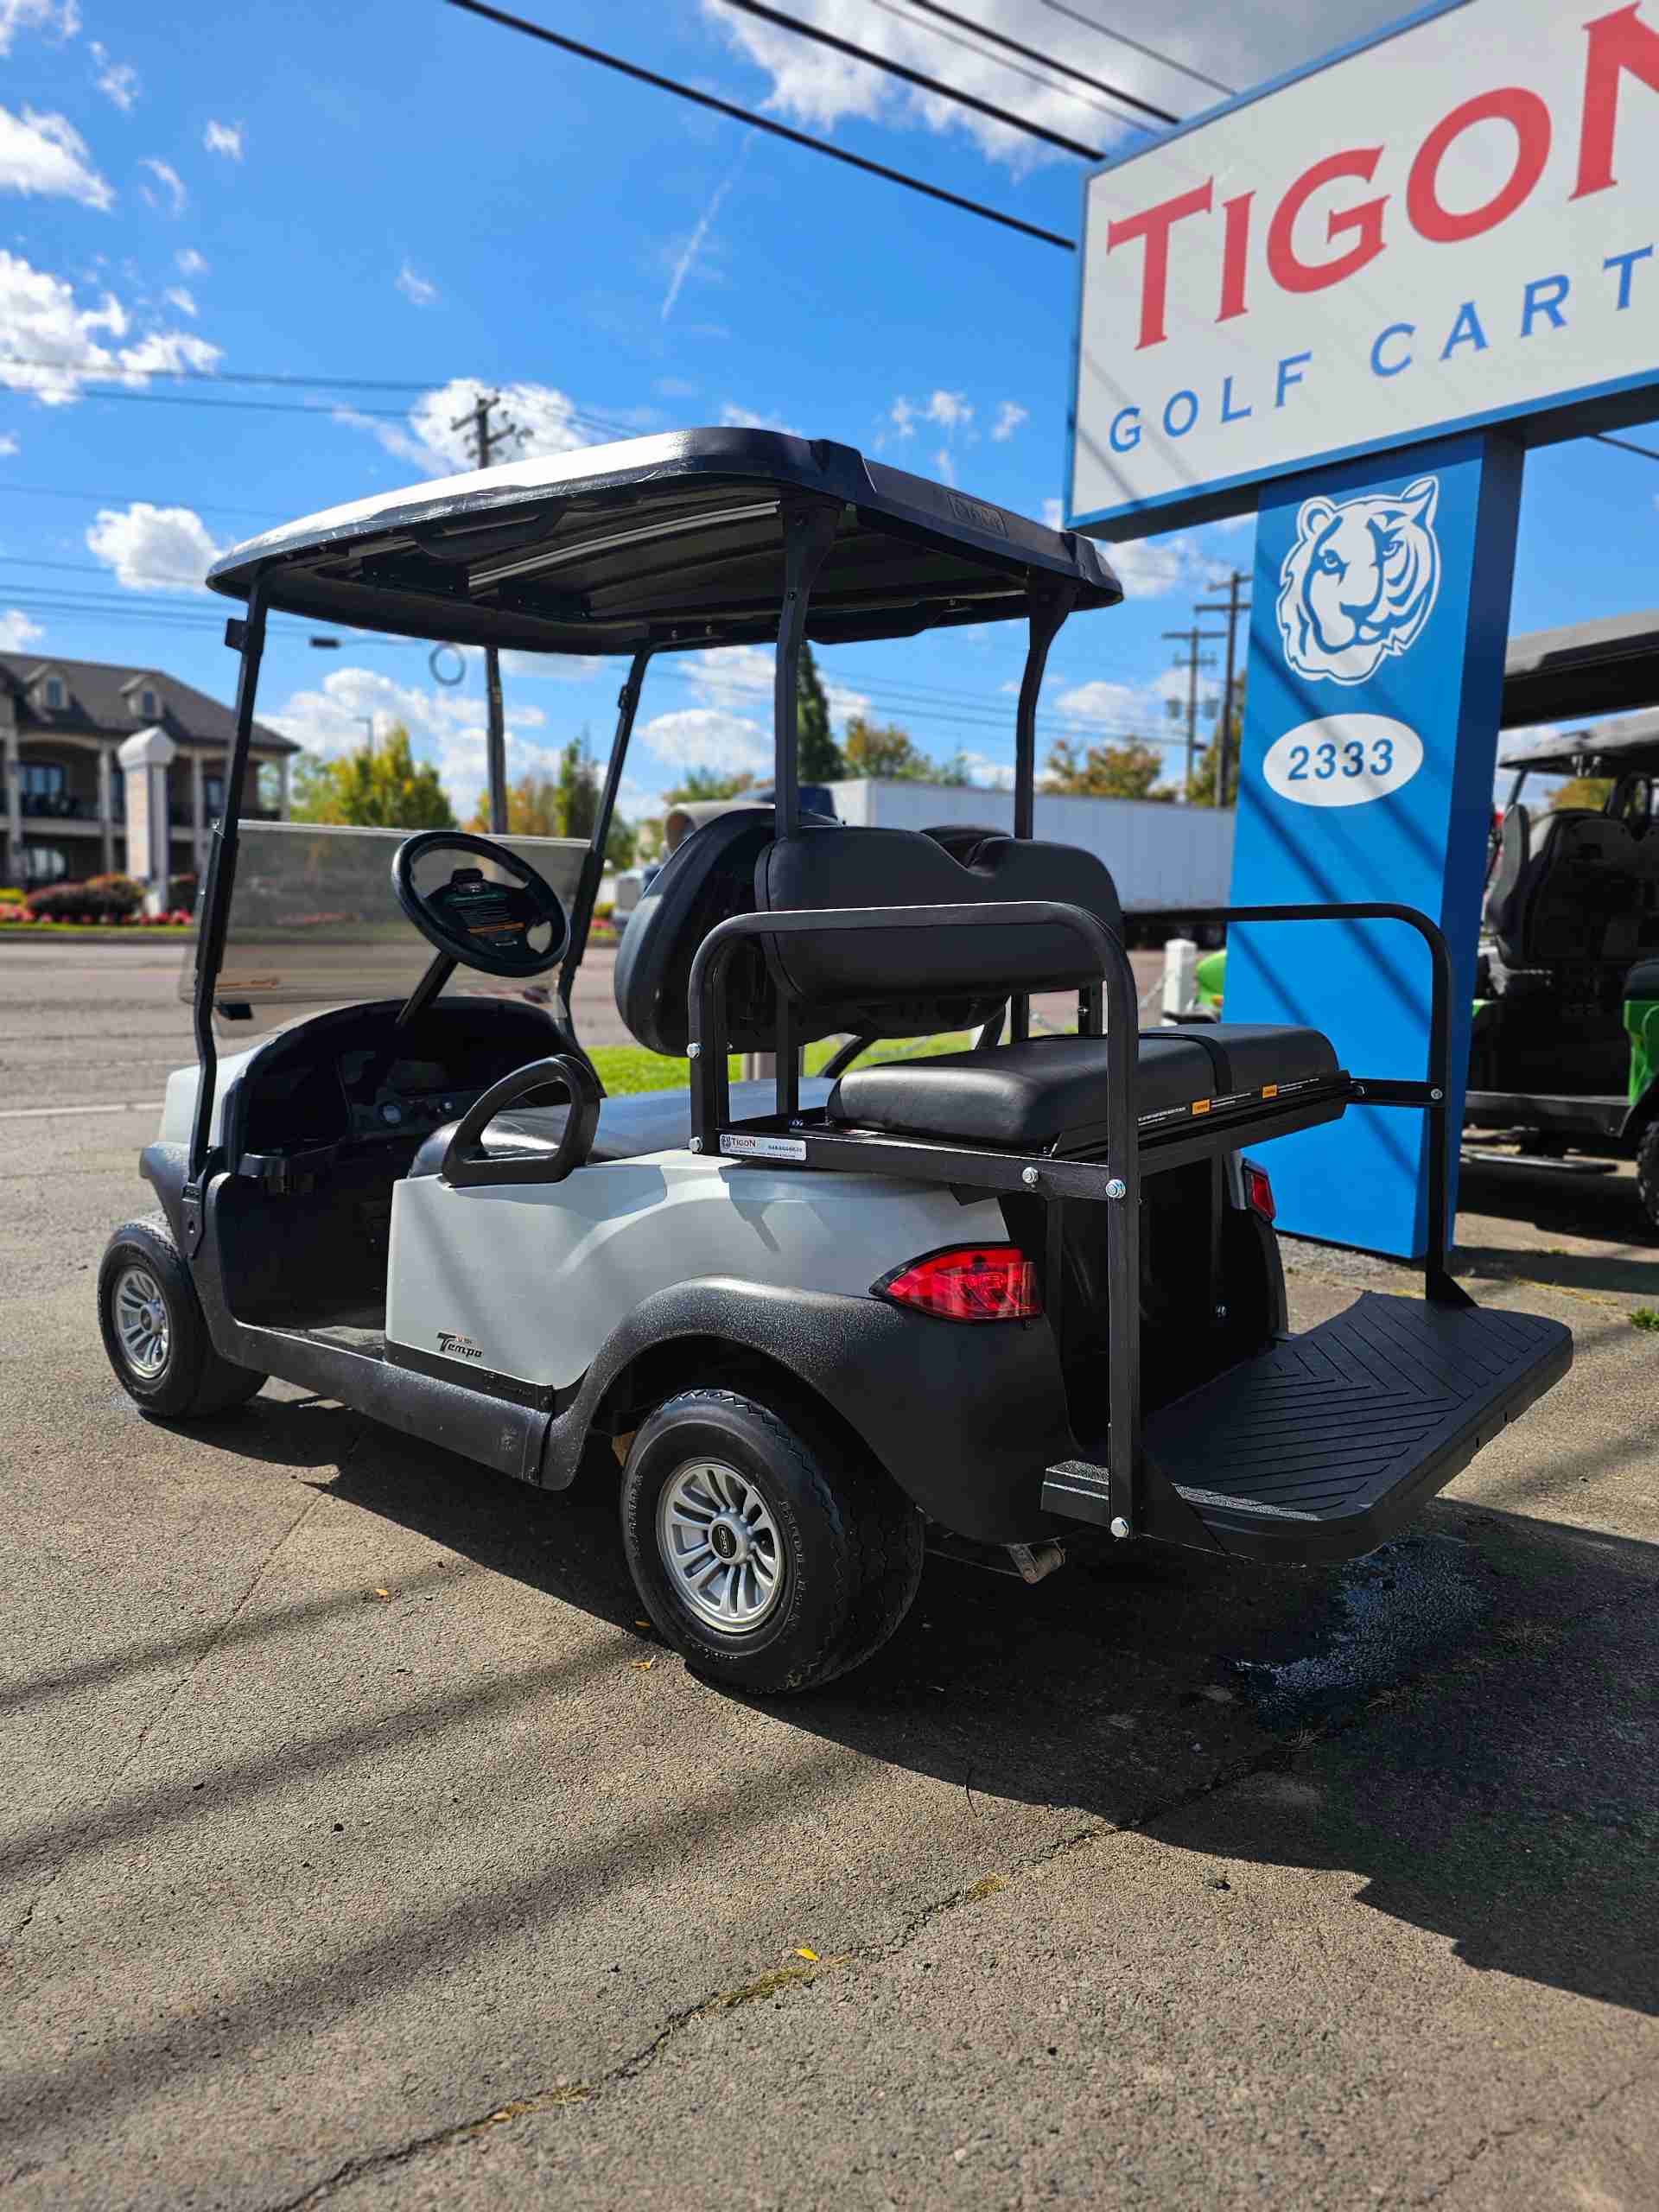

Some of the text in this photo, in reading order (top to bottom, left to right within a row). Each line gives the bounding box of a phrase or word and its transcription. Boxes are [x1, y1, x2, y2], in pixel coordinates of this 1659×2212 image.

[1109, 245, 1654, 454] GOLF CART
[1287, 737, 1395, 781] 2333
[732, 1137, 756, 1147] TIGON
[437, 1332, 483, 1357] Tempo
